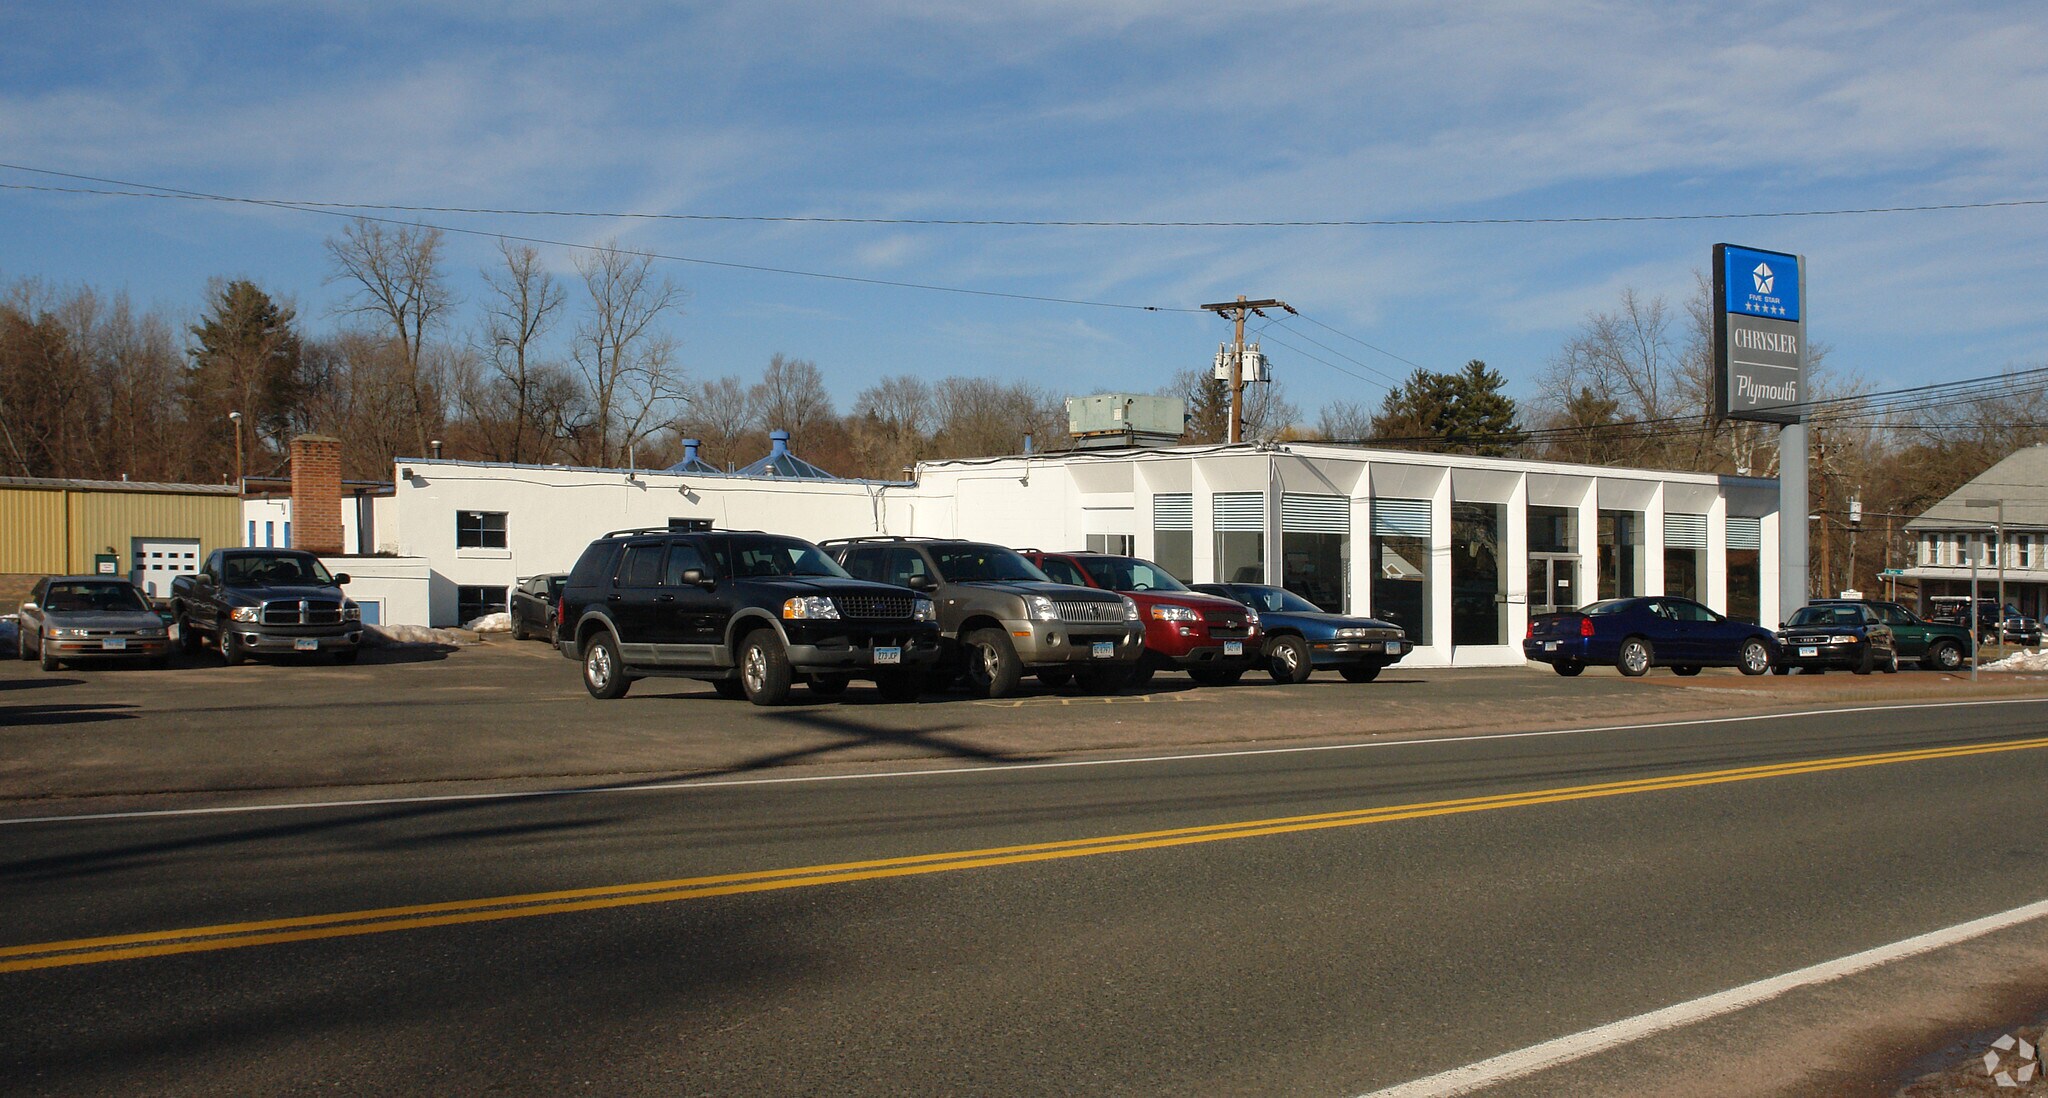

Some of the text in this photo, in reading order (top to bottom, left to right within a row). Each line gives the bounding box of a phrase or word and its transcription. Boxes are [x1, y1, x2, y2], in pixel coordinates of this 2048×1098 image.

[1749, 293, 1780, 304] FIVE STAR
[1734, 328, 1797, 354] CHRYSLER
[1736, 374, 1796, 405] Plymouth
